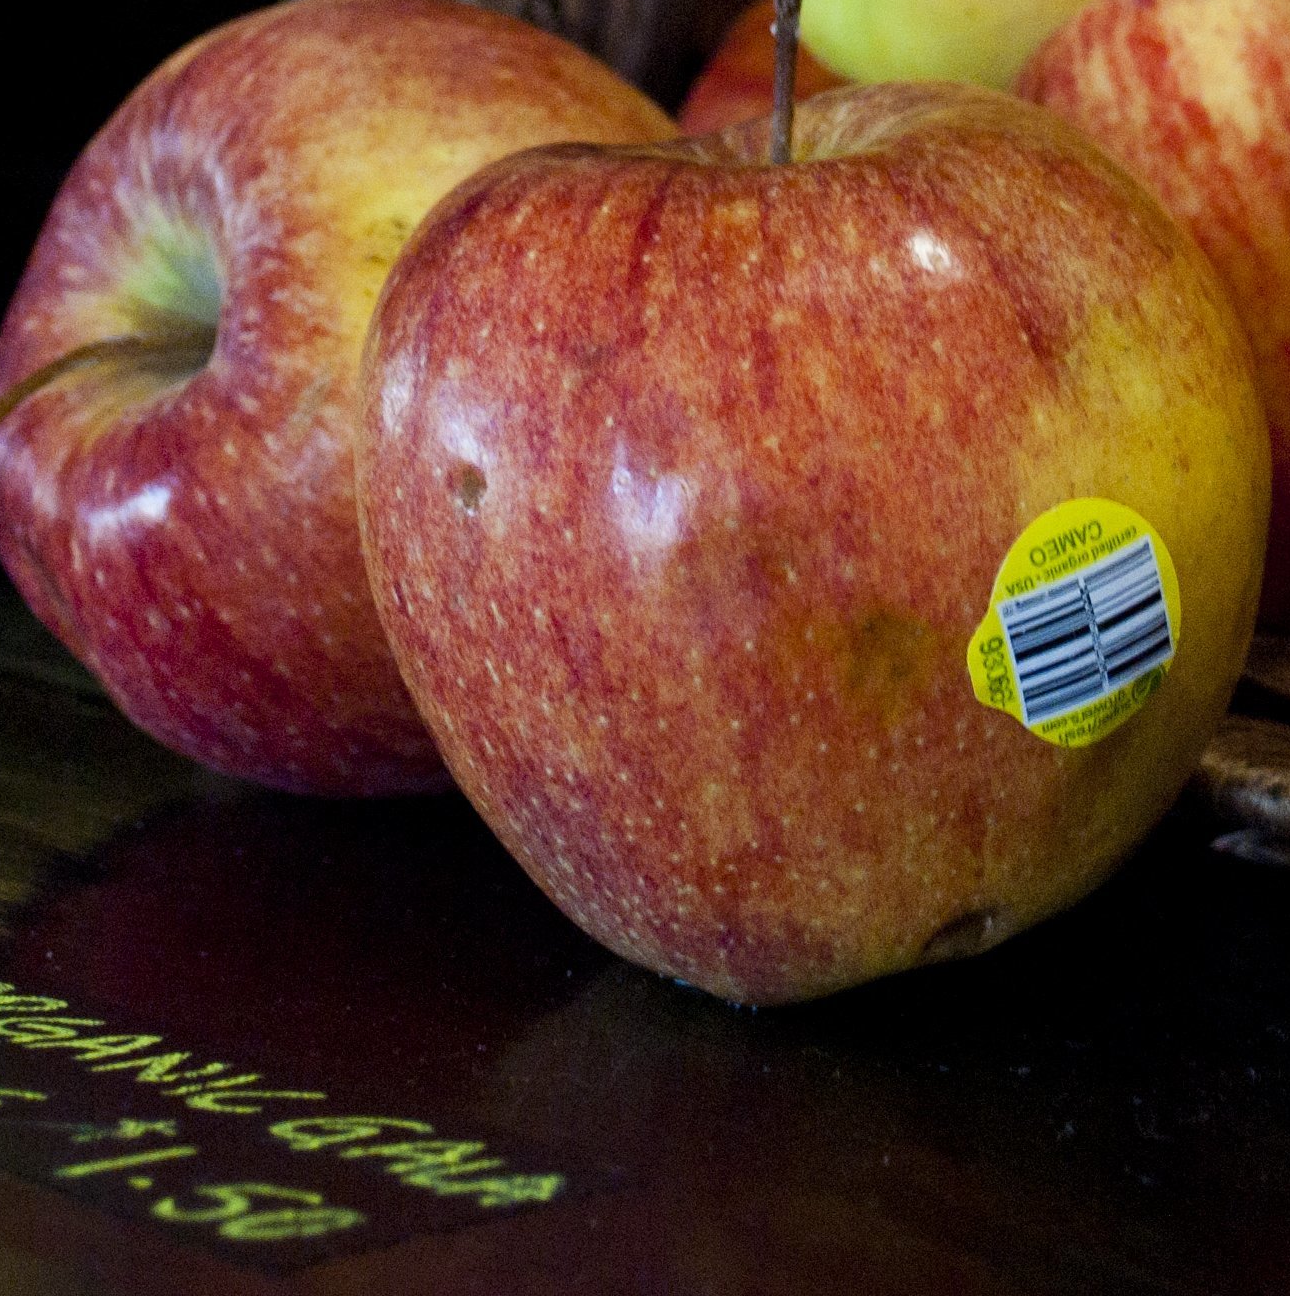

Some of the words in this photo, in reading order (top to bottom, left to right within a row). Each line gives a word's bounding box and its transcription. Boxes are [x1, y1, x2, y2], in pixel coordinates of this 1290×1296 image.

[1029, 520, 1103, 567] CAMEO
[1090, 525, 1138, 561] certified
[1005, 576, 1035, 595] USA
[1045, 552, 1091, 583] organic
[269, 1115, 566, 1208] GALA
